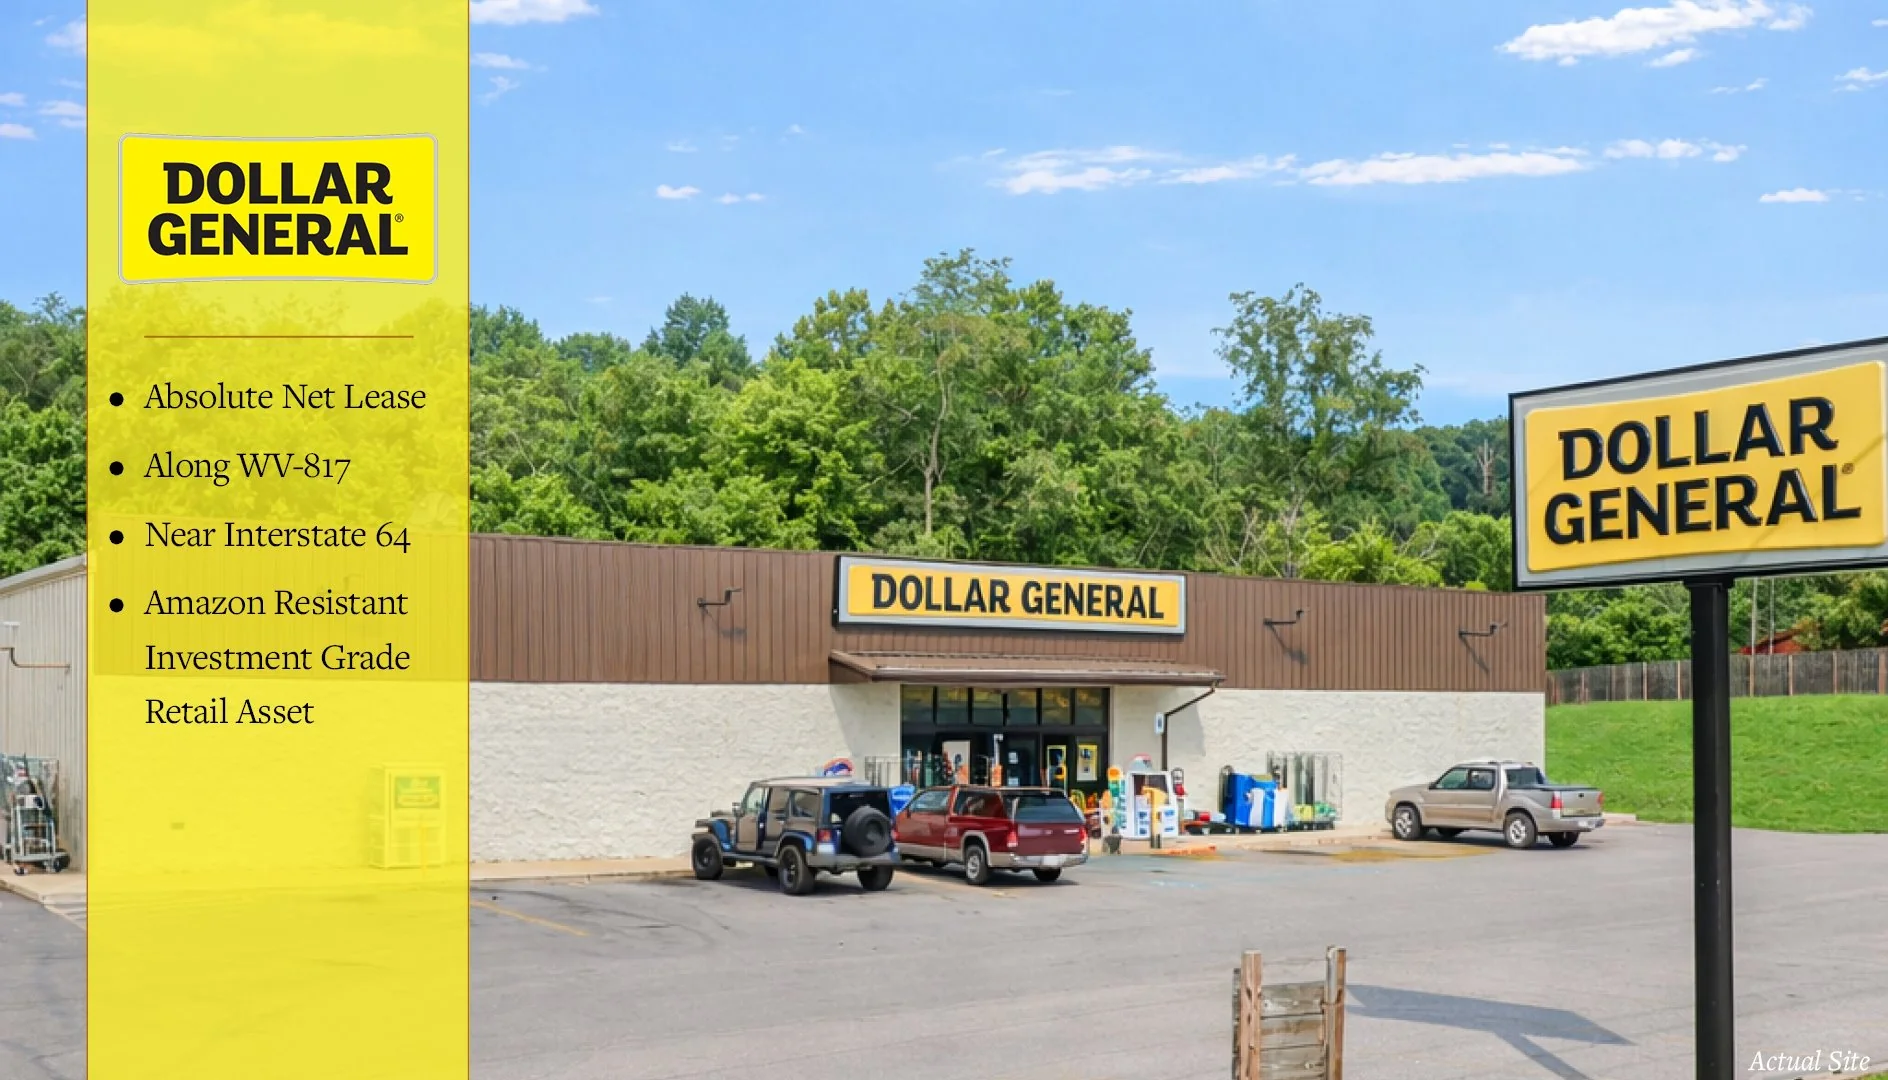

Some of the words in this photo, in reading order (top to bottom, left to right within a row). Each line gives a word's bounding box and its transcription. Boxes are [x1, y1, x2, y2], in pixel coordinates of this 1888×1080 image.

[1558, 396, 1839, 480] DOLLAR
[871, 573, 1011, 613] DOLLAR
[1021, 580, 1164, 619] GENERAL
